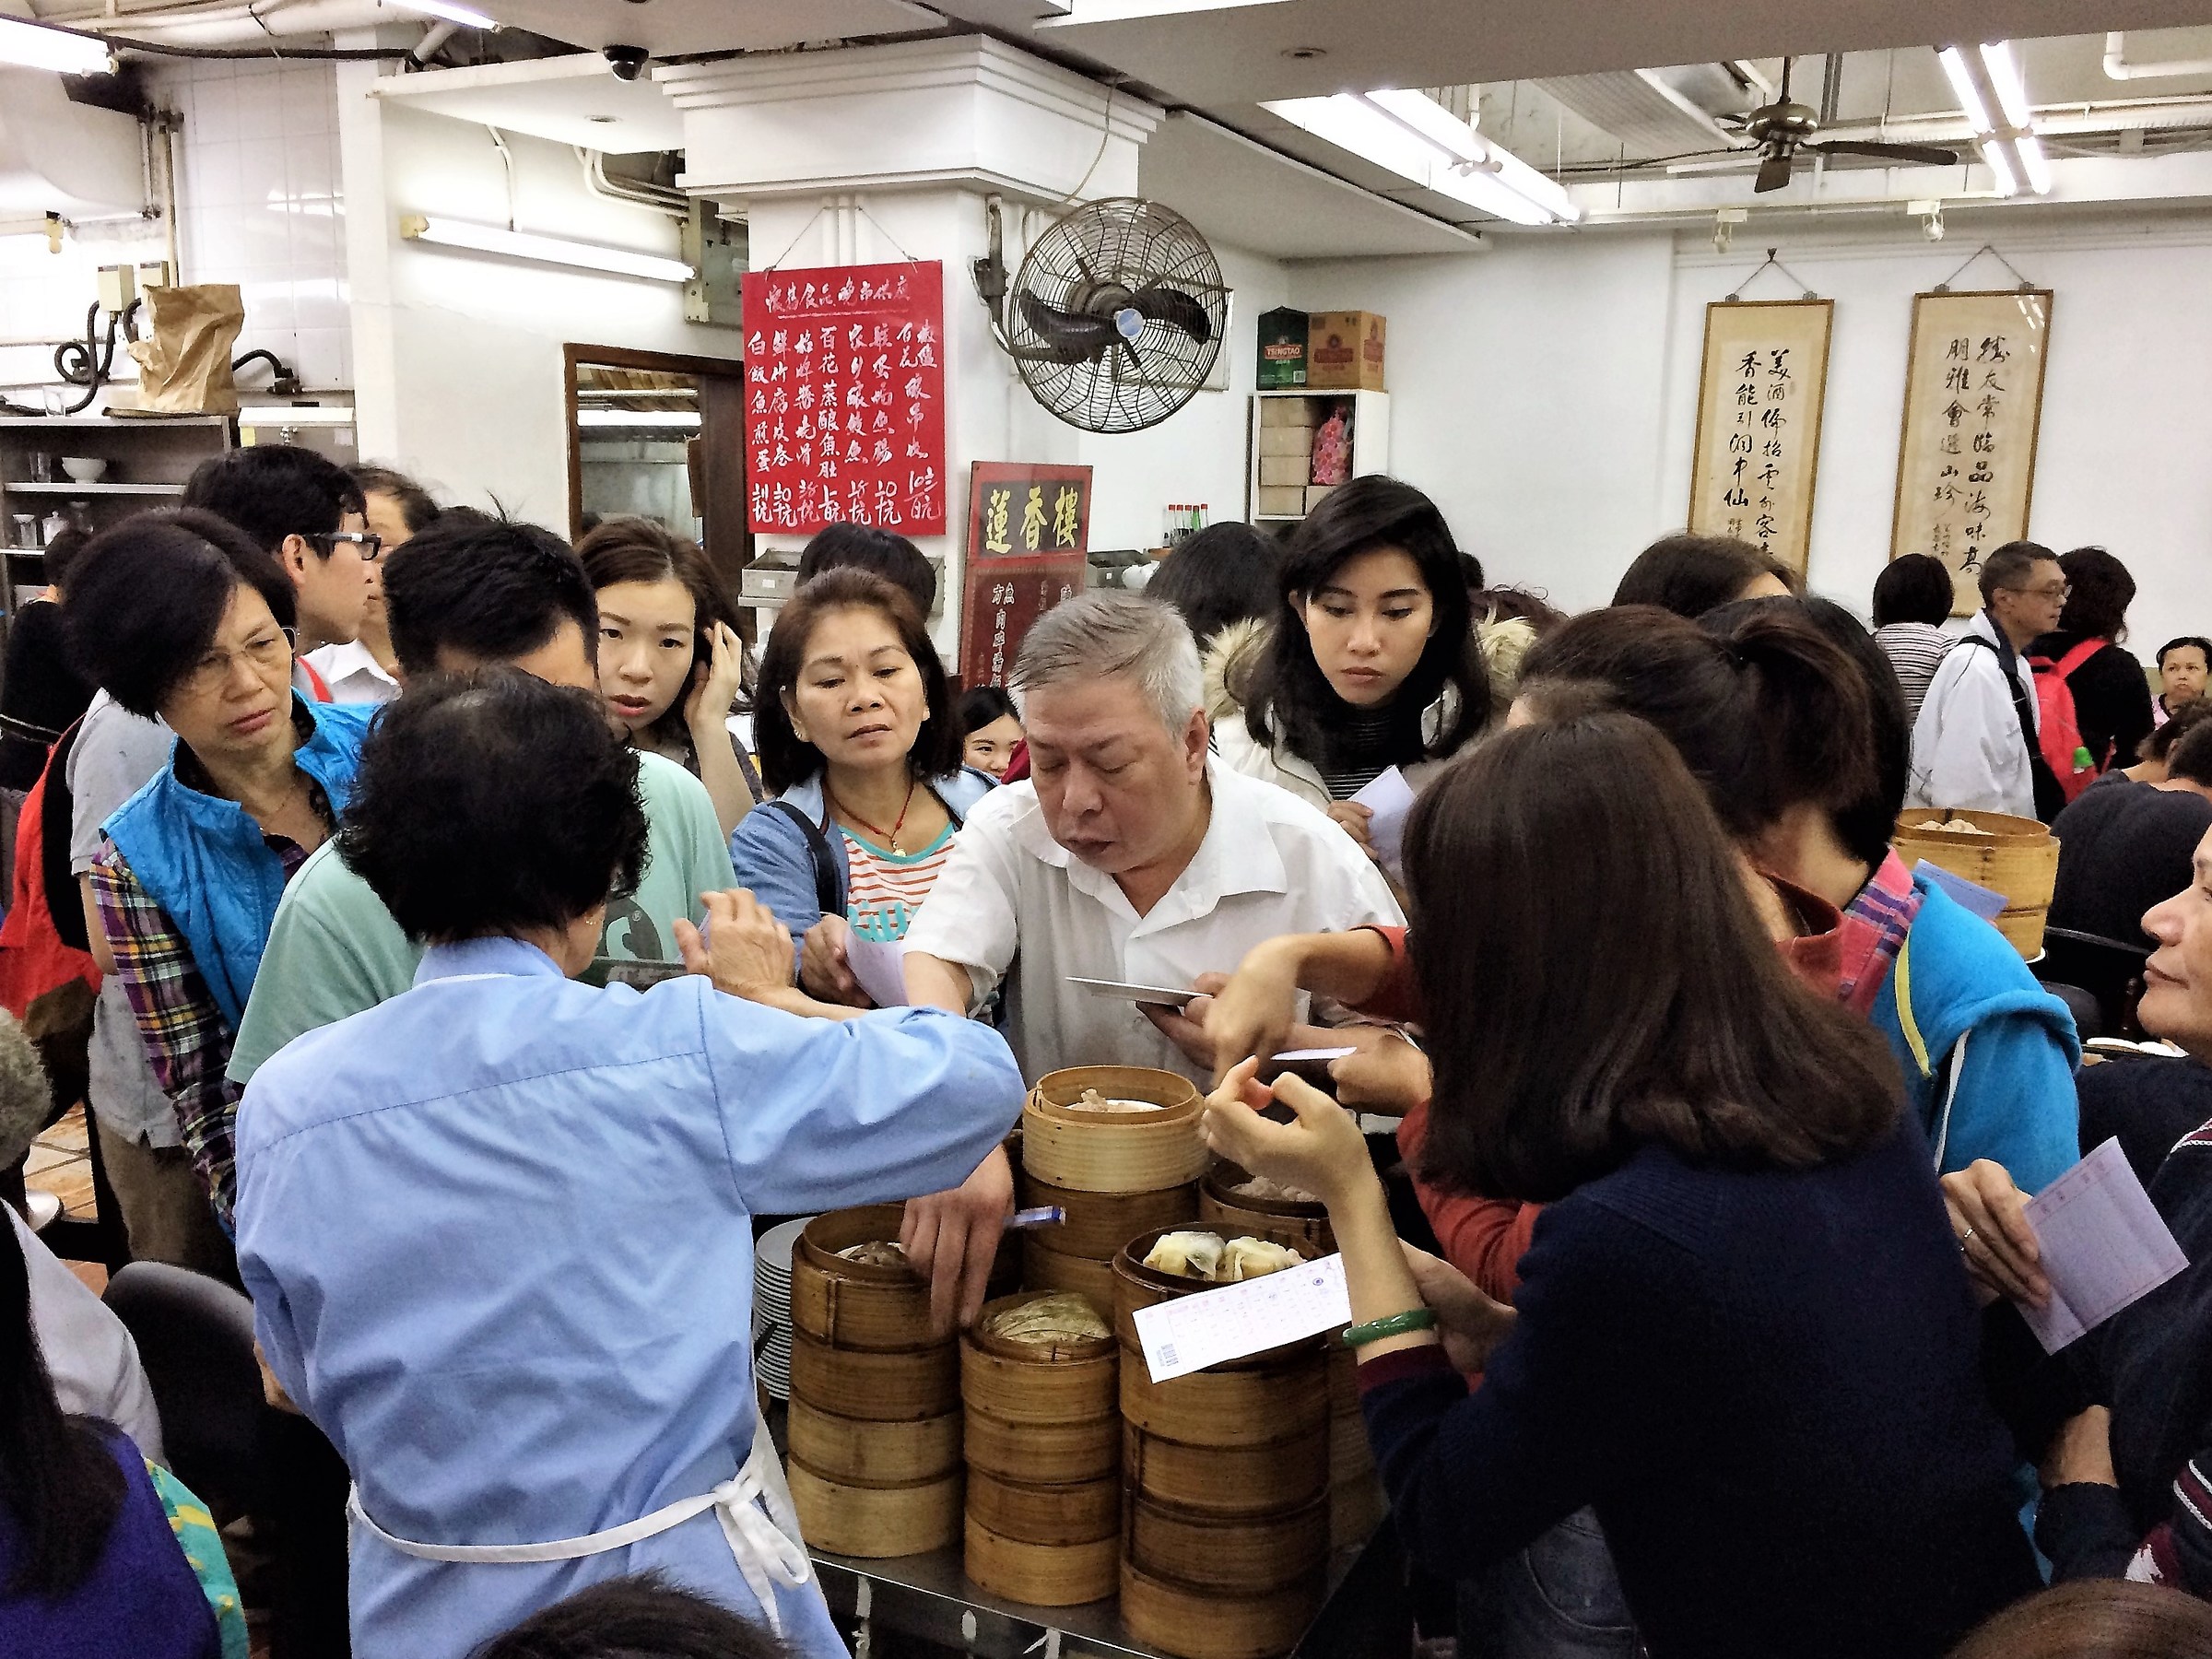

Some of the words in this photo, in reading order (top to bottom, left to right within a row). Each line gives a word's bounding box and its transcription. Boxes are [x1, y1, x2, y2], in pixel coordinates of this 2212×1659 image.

[1267, 347, 1300, 356] TSINGTAO
[985, 485, 1078, 554] 蓮香樓
